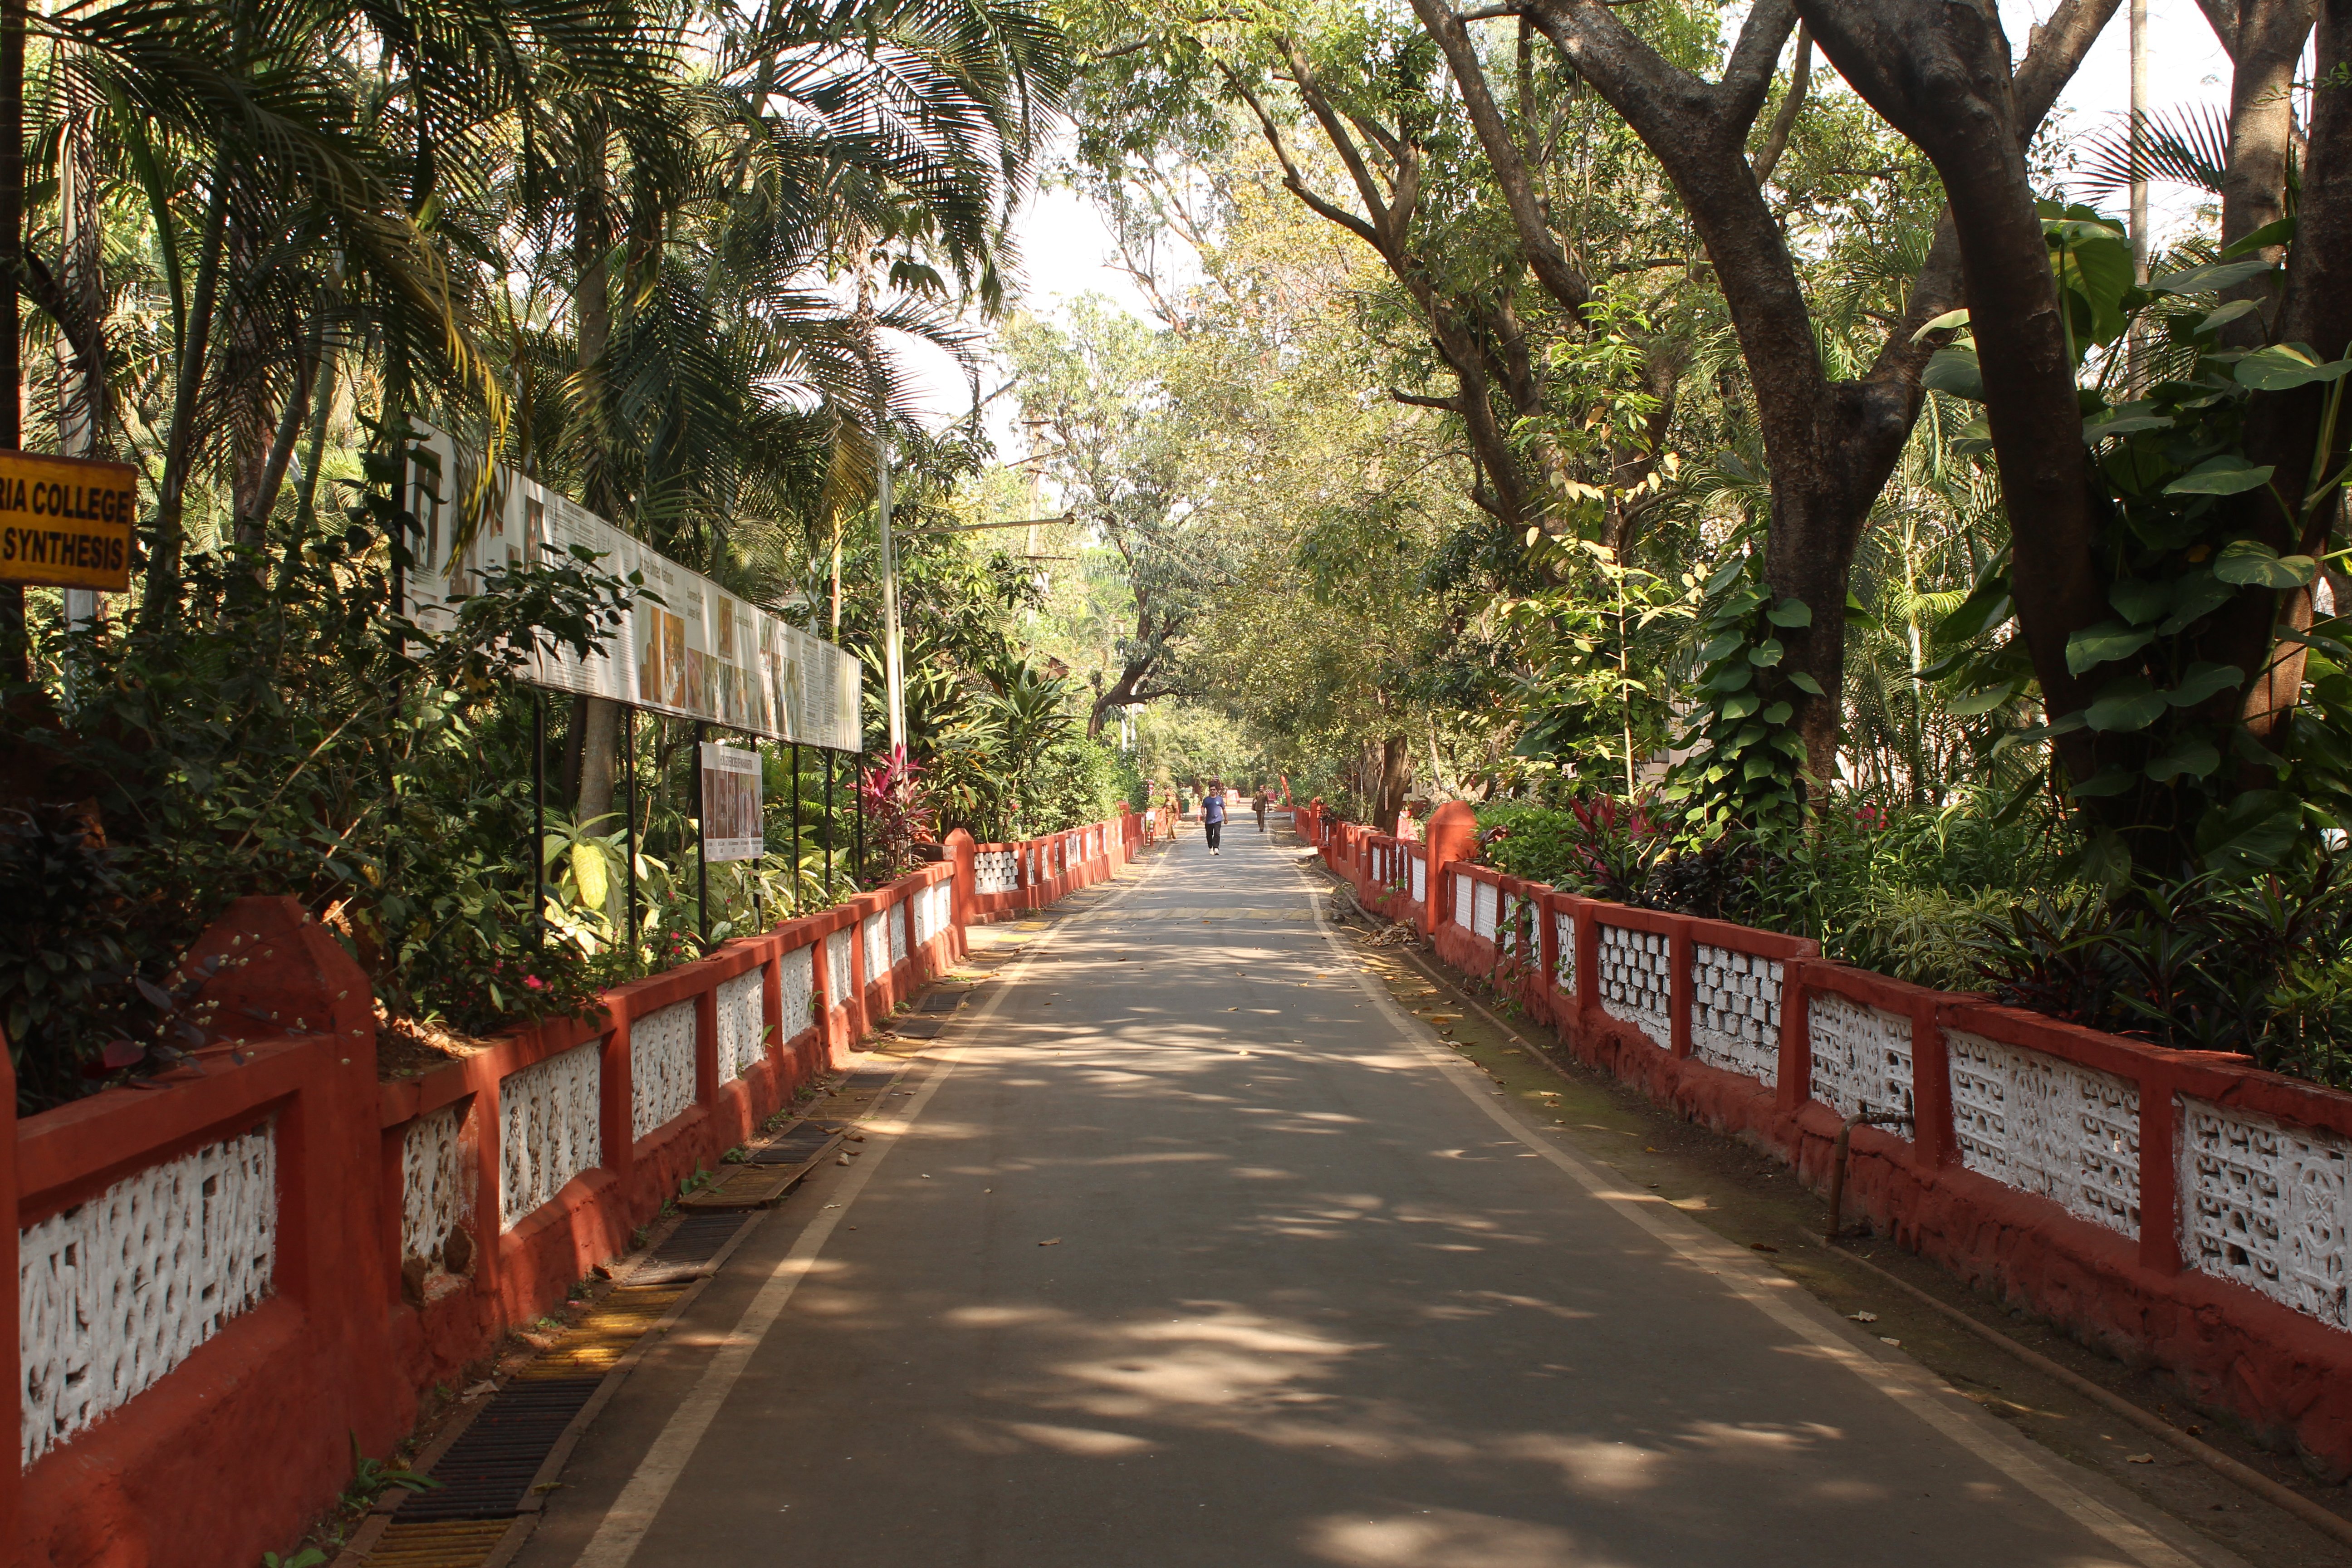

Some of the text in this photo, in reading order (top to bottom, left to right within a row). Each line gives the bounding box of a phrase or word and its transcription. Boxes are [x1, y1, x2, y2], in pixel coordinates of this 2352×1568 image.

[33, 481, 129, 524] COLLEGE
[3, 527, 123, 571] SYNTHESIS
[650, 559, 661, 579] United
